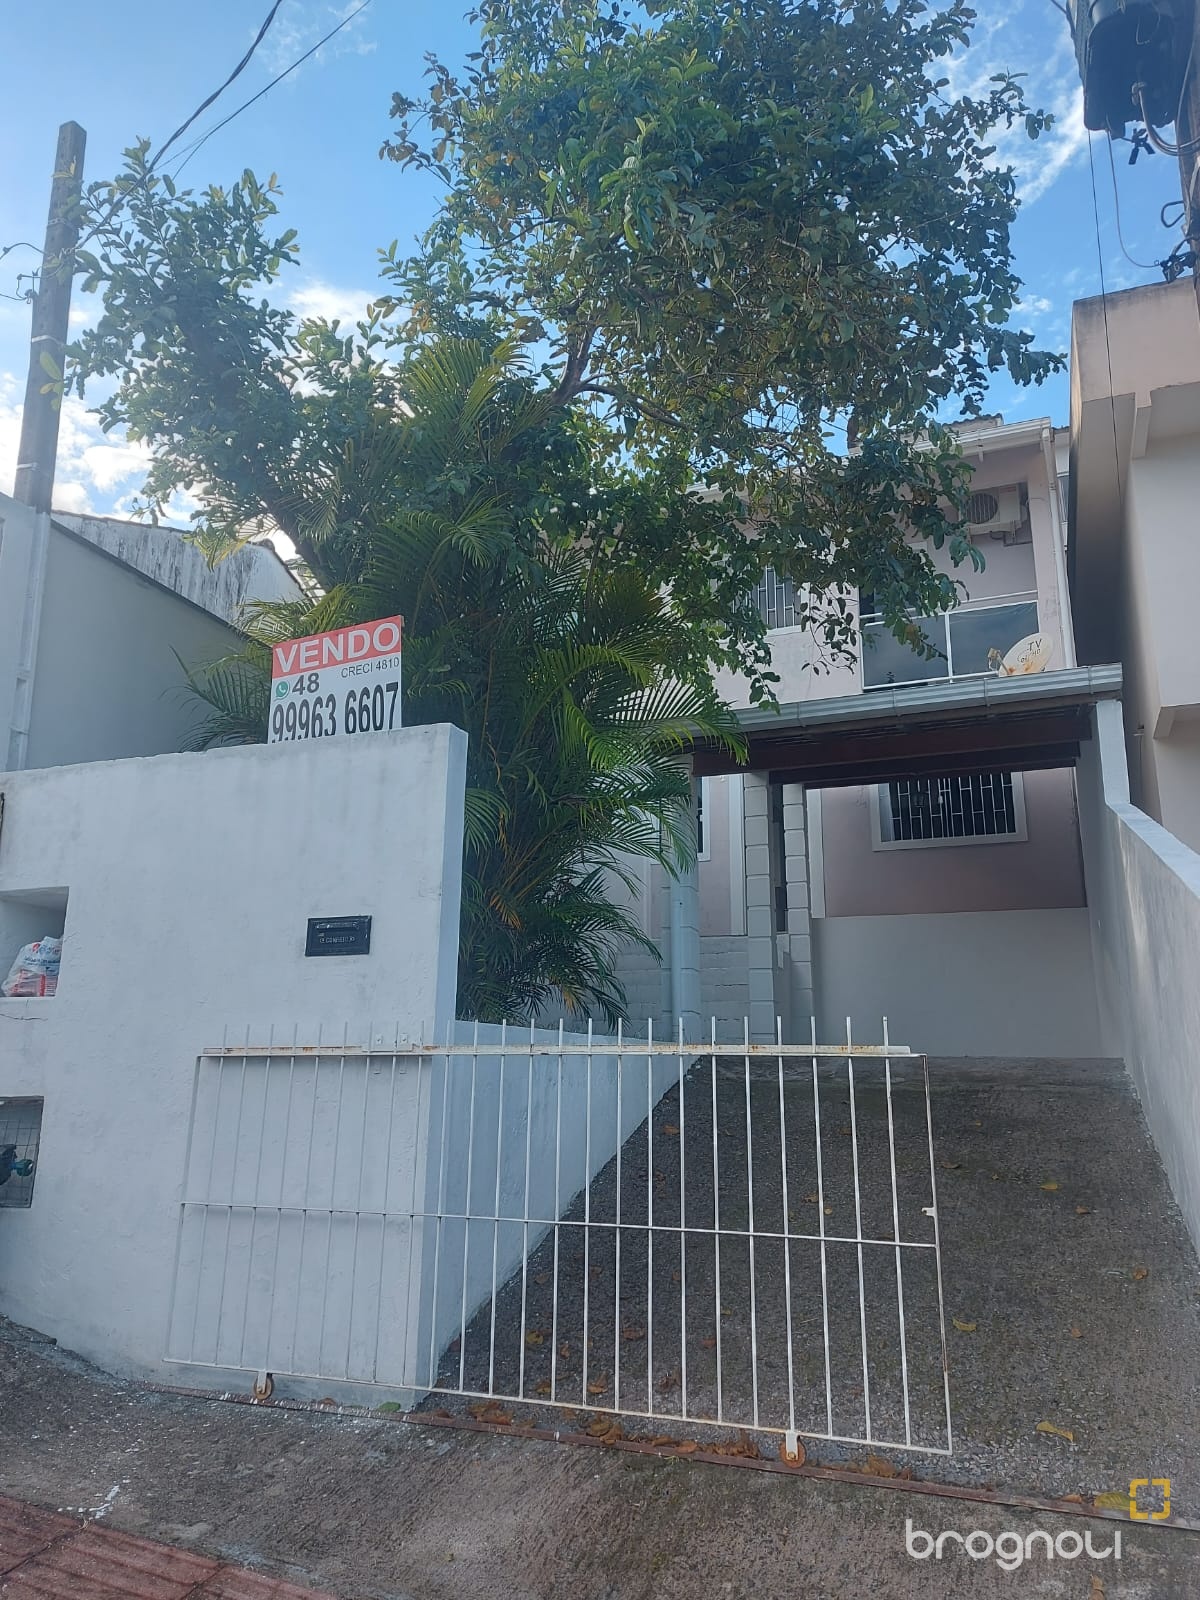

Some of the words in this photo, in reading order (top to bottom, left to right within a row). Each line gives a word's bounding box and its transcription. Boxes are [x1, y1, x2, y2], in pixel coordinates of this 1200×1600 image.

[275, 622, 400, 673] VENDO
[1027, 638, 1042, 652] TV
[340, 662, 373, 678] CRECI
[375, 656, 400, 672] 4810
[292, 672, 320, 695] 48
[271, 693, 337, 744] 99963
[344, 681, 399, 735] 6607
